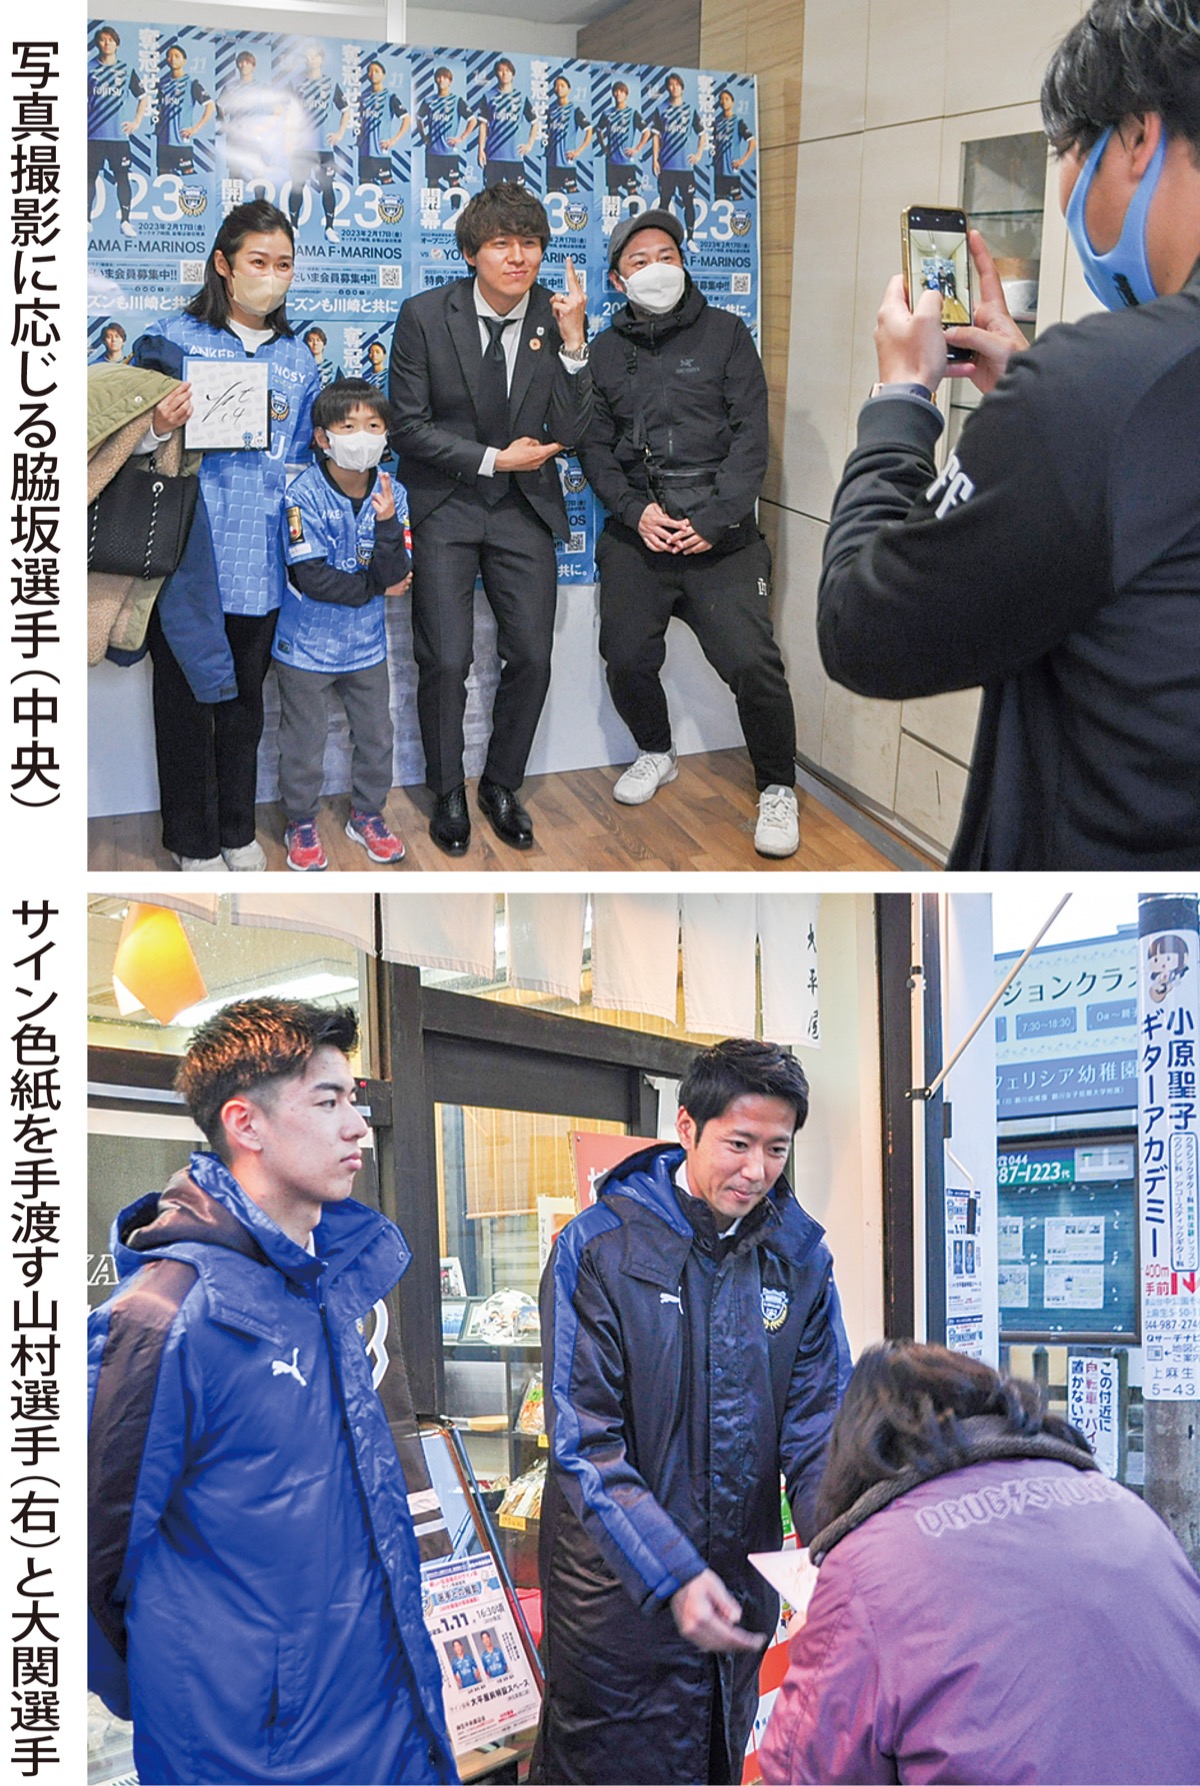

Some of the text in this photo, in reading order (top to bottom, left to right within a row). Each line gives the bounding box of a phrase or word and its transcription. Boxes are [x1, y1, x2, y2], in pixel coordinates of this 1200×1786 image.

[1166, 1007, 1197, 1130] 小原聖子
[1143, 1008, 1168, 1258] ギターアカデミー
[1099, 1361, 1113, 1433] この付近に
[1152, 1383, 1195, 1396] 5-43
[1153, 1367, 1194, 1379] 上麻生
